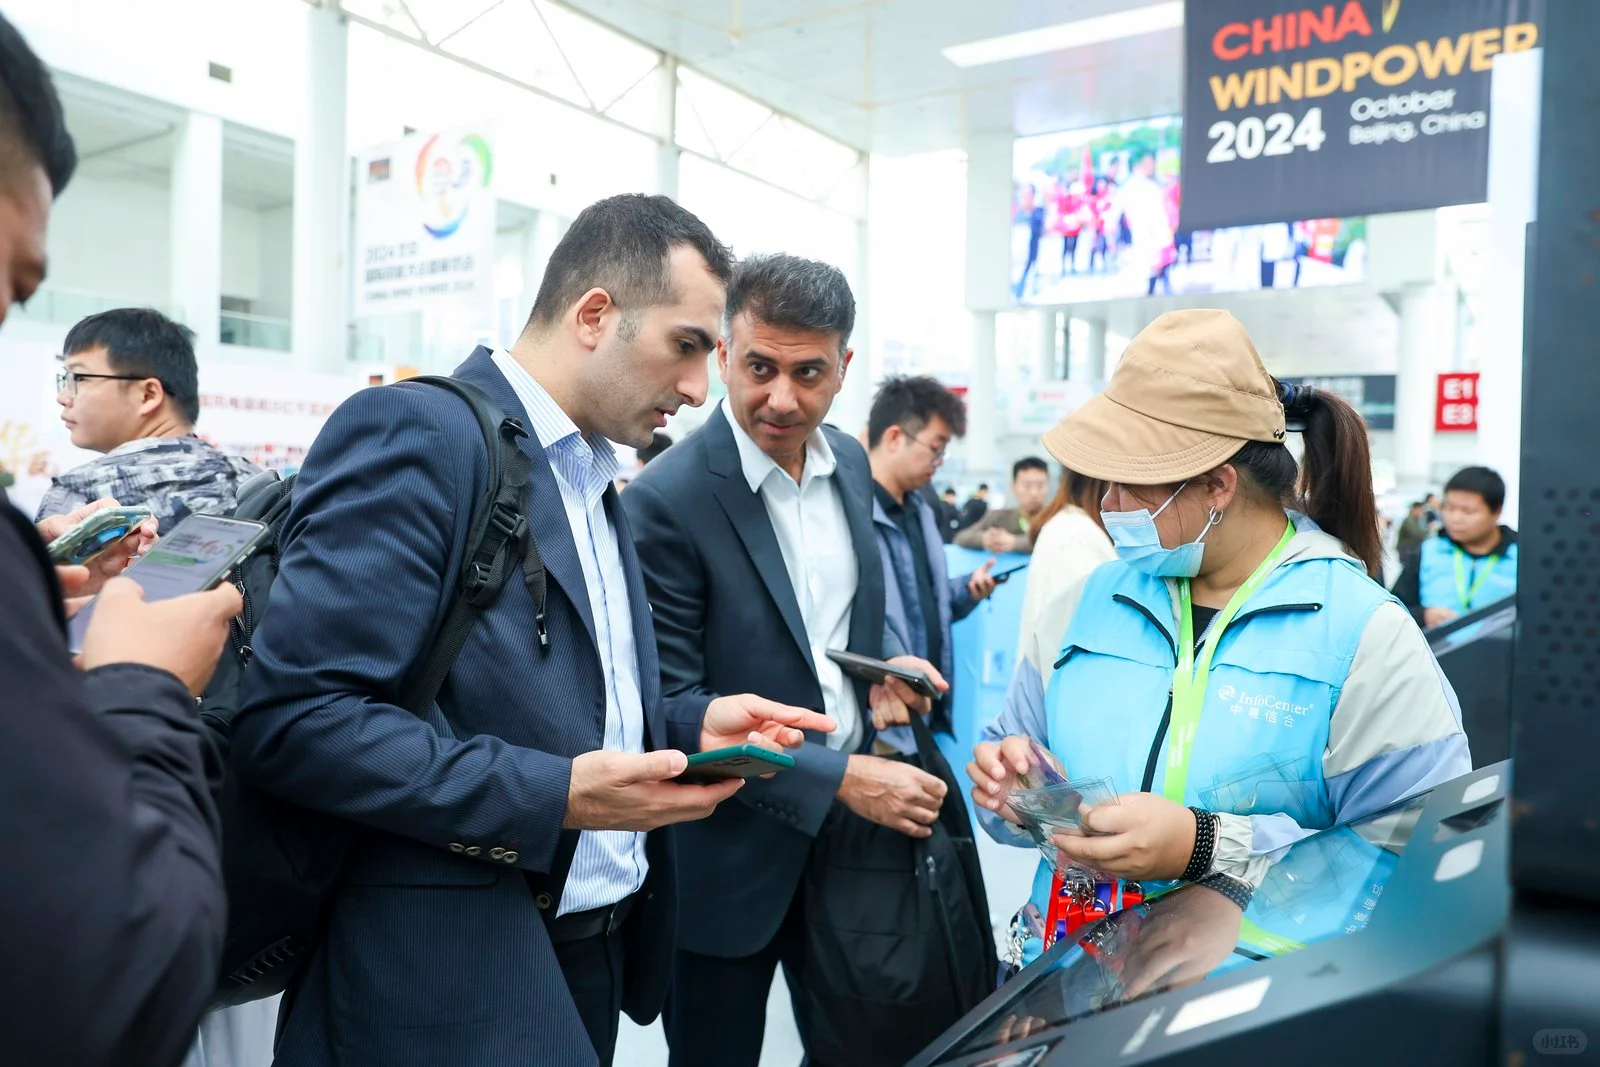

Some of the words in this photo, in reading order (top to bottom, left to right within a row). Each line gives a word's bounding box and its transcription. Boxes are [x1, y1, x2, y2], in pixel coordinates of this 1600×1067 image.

[1211, 1, 1372, 61] CHINA
[1350, 88, 1457, 121] October
[1206, 107, 1326, 163] 2024
[1349, 121, 1419, 145] Beijing,
[1420, 110, 1487, 136] China
[1443, 377, 1473, 400] E1
